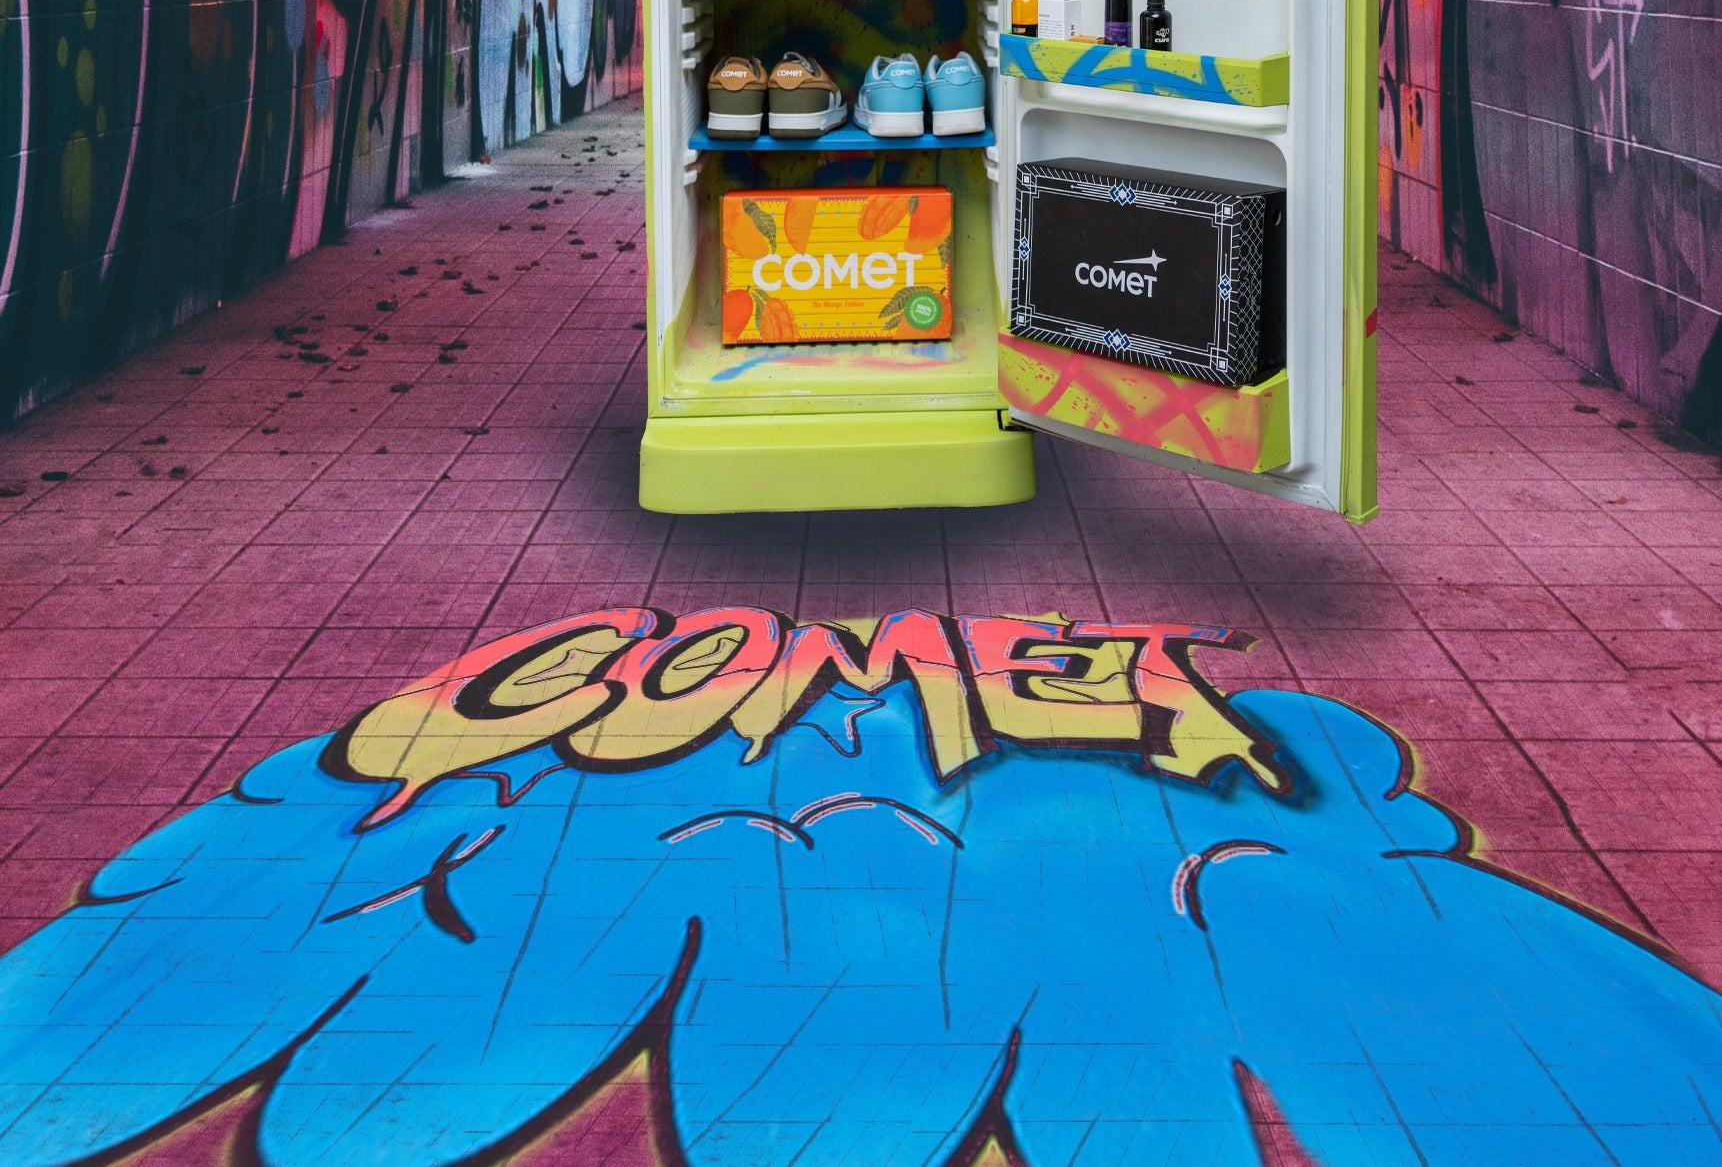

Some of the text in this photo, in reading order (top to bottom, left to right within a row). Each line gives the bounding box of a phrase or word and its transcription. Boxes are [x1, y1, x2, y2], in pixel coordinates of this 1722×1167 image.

[752, 251, 923, 291] COMeT
[1075, 262, 1157, 298] COMeT
[318, 606, 1293, 834] COMET
